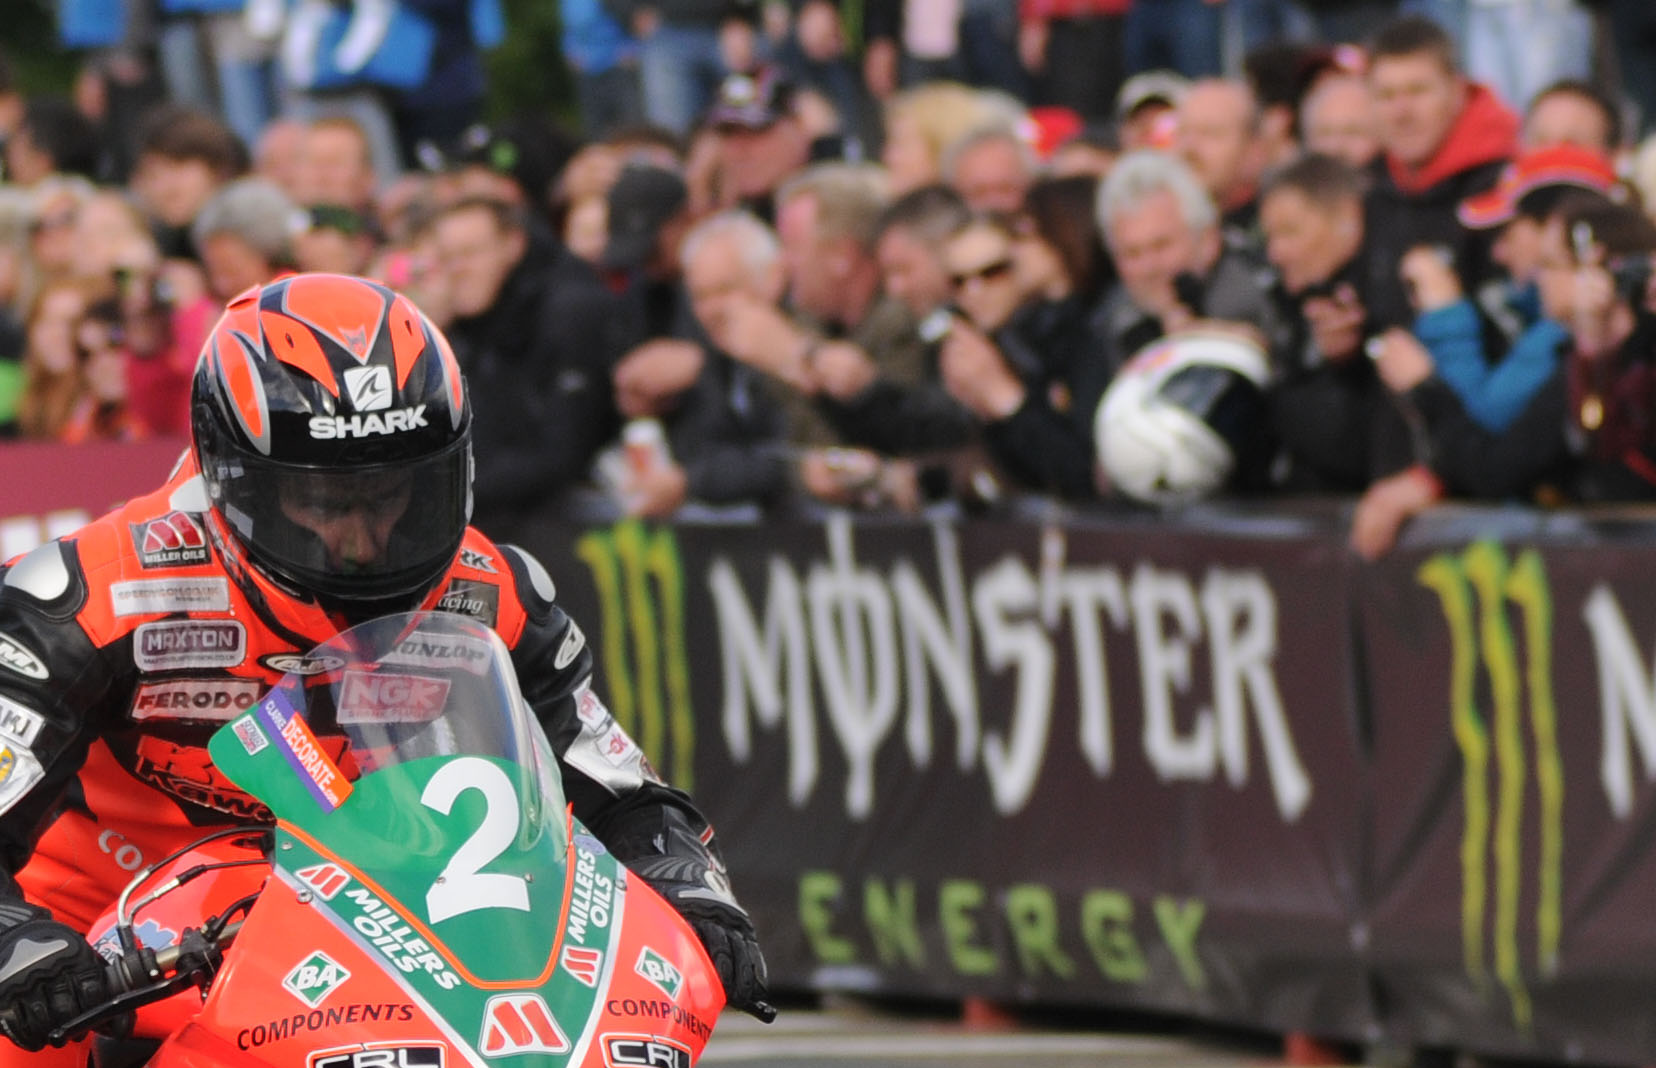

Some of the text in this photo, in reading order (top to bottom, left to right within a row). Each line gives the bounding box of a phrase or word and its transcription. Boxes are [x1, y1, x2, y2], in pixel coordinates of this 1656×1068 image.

[310, 405, 428, 439] SHARK
[182, 549, 205, 560] OILS
[147, 631, 233, 651] MAXTON
[709, 508, 1311, 822] MONSTER
[137, 692, 256, 710] FERODO
[344, 679, 442, 709] NGK
[420, 757, 531, 925] 2
[568, 847, 596, 944] MILLERS
[590, 873, 613, 928] OILS
[345, 887, 461, 990] MILLERS
[353, 915, 421, 973] OILS
[798, 868, 1209, 992] ENERGY
[296, 964, 337, 990] BA
[644, 959, 677, 984] BA
[237, 1003, 414, 1051] COMPONENTS
